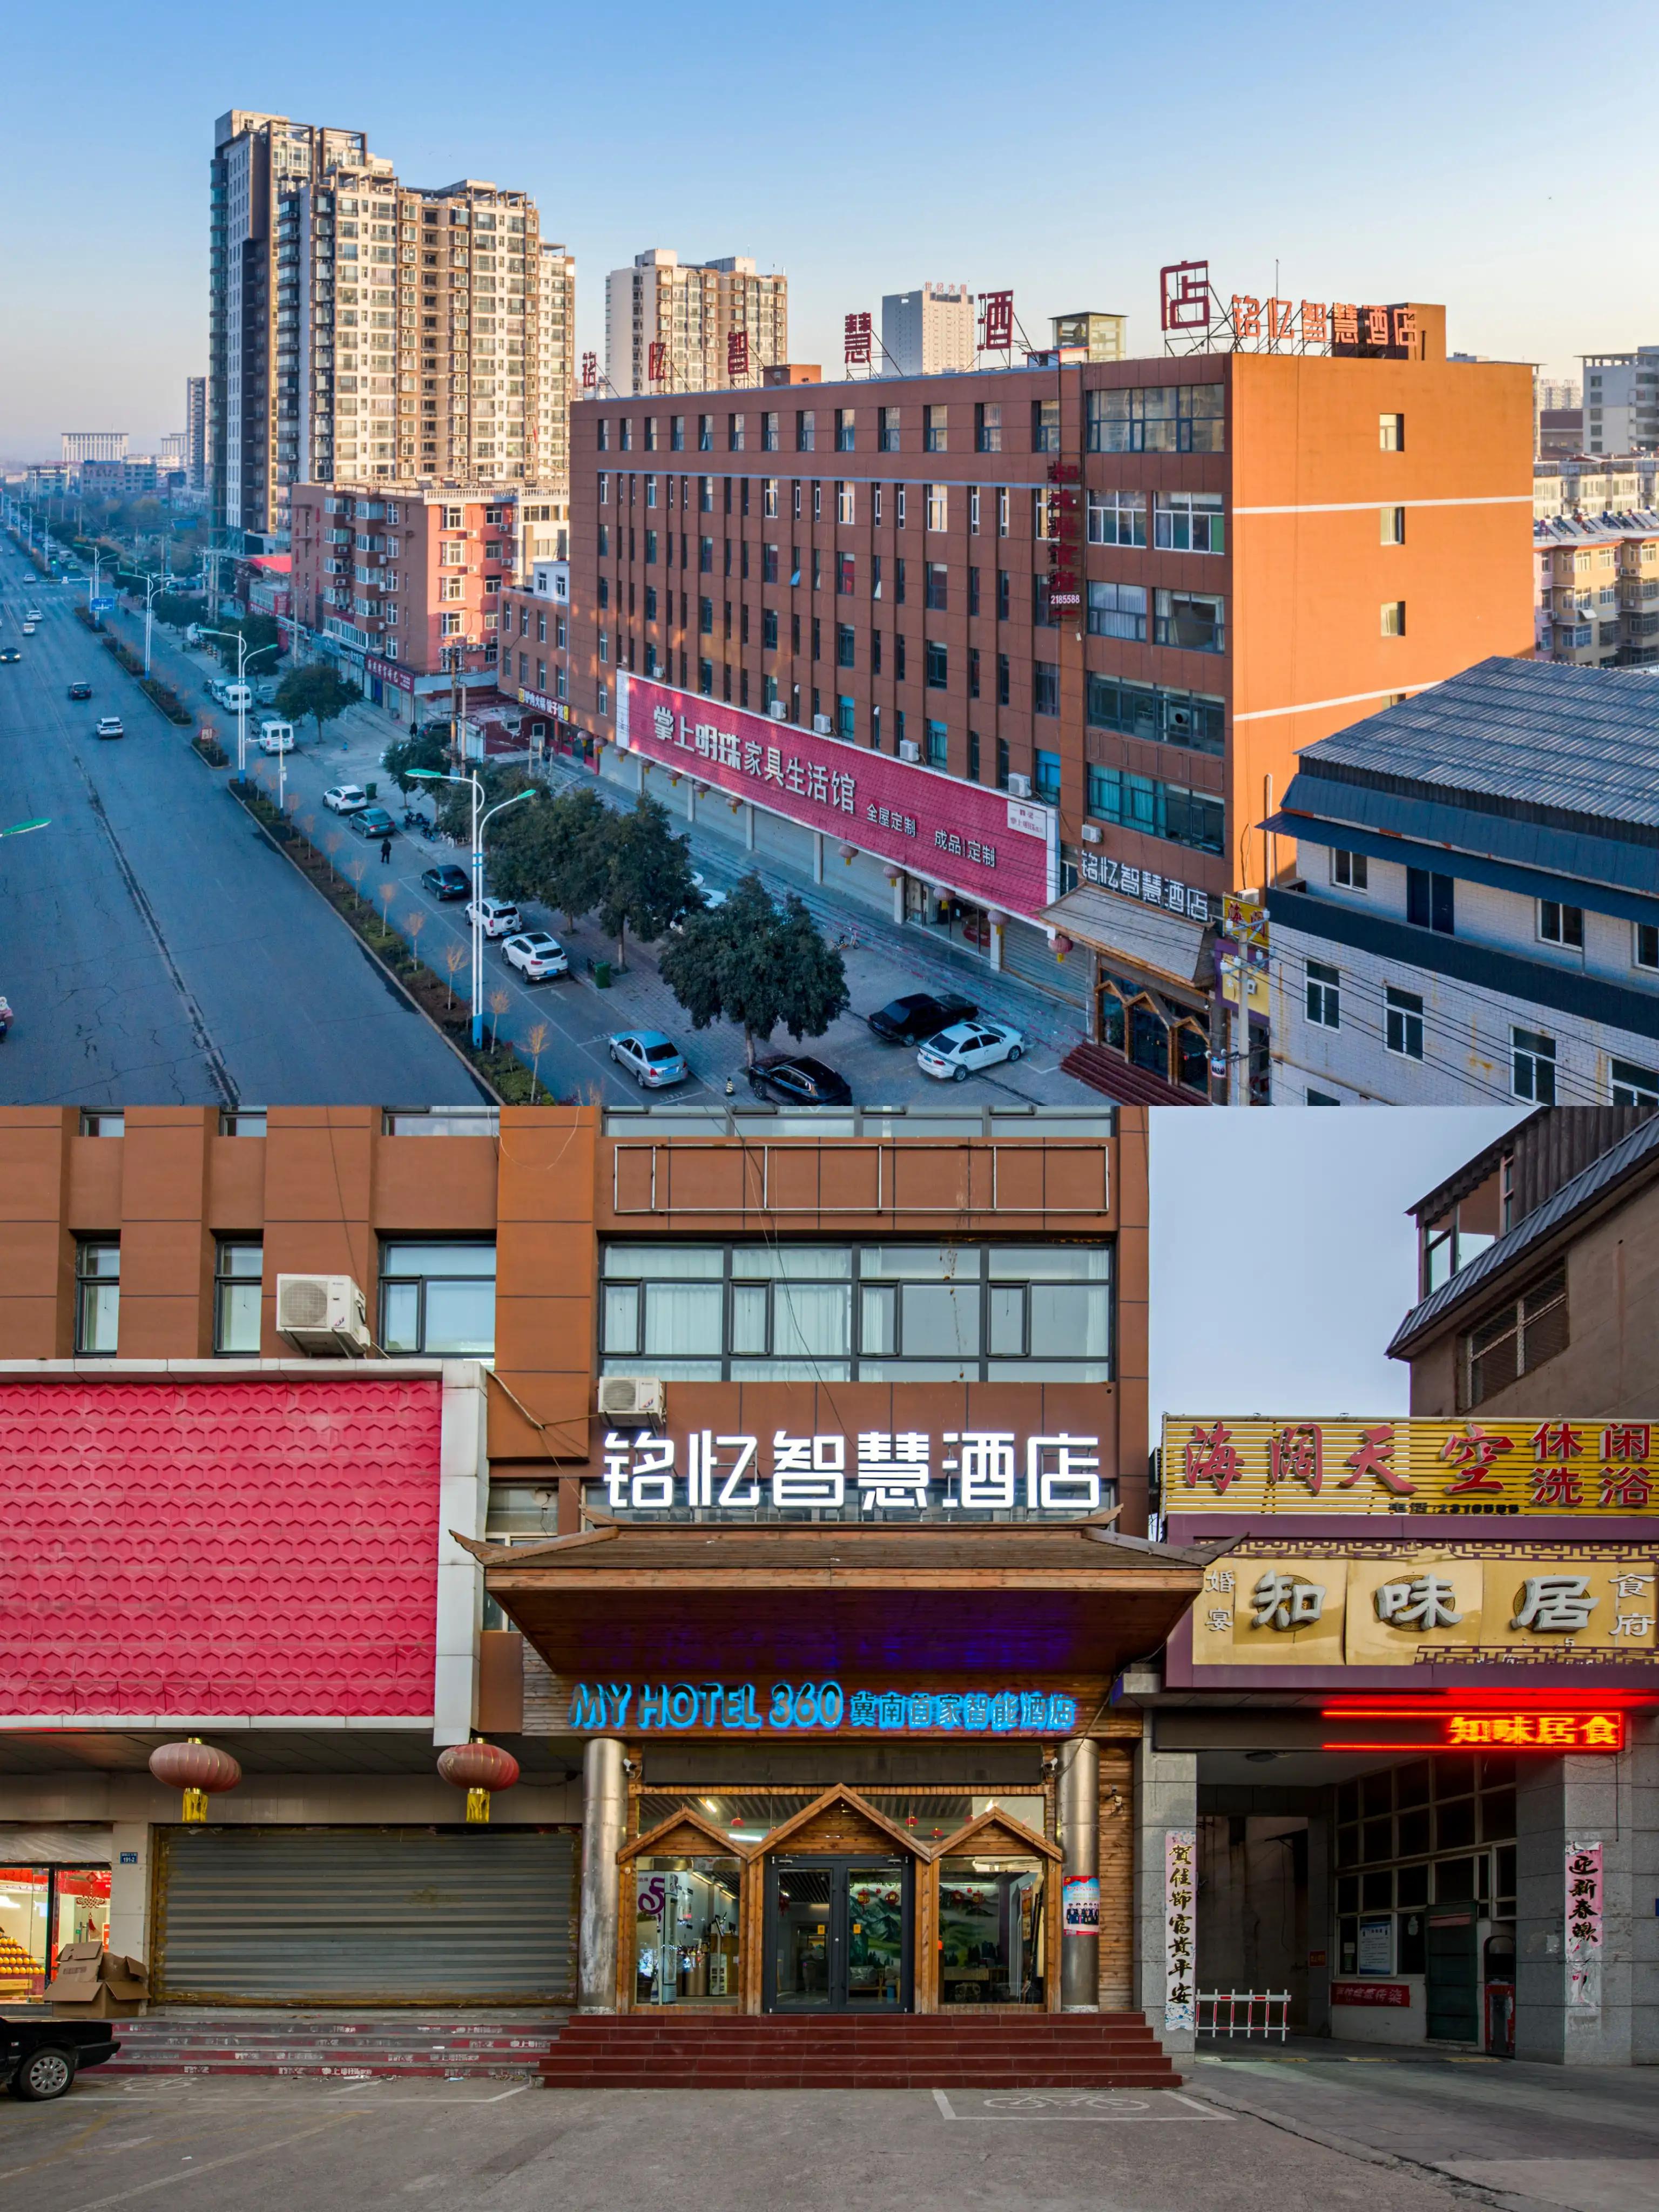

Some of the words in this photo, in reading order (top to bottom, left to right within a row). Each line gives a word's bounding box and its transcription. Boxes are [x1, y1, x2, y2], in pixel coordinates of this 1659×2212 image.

[1232, 295, 1419, 348] 铭忆智慧酒店
[1051, 595, 1080, 604] 2185588
[653, 705, 857, 815] 掌上明珠家具生活馆
[866, 802, 916, 838] 全屋定制
[1081, 849, 1208, 921] 铭忆智慧酒店
[603, 1430, 1100, 1510] 铭忆智慧酒店
[1185, 1420, 1515, 1496] 海阔天空
[1528, 1422, 1651, 1462] 休闲
[1529, 1466, 1655, 1507] 洗浴
[1205, 1570, 1236, 1632] 婚宴
[1252, 1568, 1600, 1633] 知味居
[1609, 1572, 1655, 1637] 食府
[570, 1682, 632, 1726] MY
[638, 1682, 761, 1727] HOTEL
[769, 1681, 844, 1727] 360
[849, 1691, 1076, 1731] 冀南首家智能酒店
[1448, 1715, 1620, 1745] 知味居食
